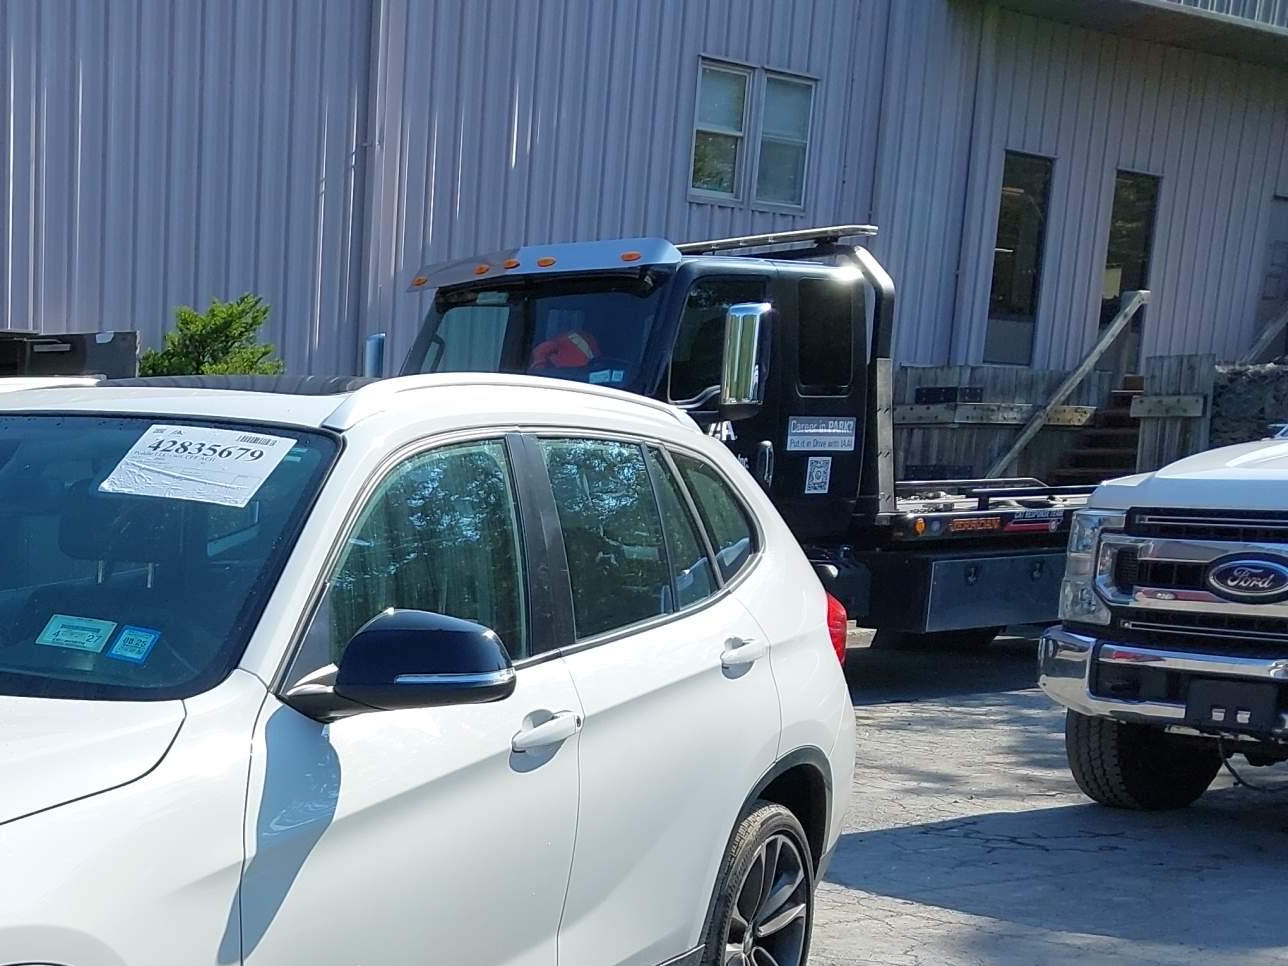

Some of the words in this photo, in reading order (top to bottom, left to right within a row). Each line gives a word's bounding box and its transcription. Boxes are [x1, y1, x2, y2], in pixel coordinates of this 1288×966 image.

[791, 420, 816, 433] Career
[818, 420, 826, 432] in
[828, 420, 854, 433] PARK?
[148, 438, 264, 462] 42835679
[1227, 567, 1274, 588] Ford
